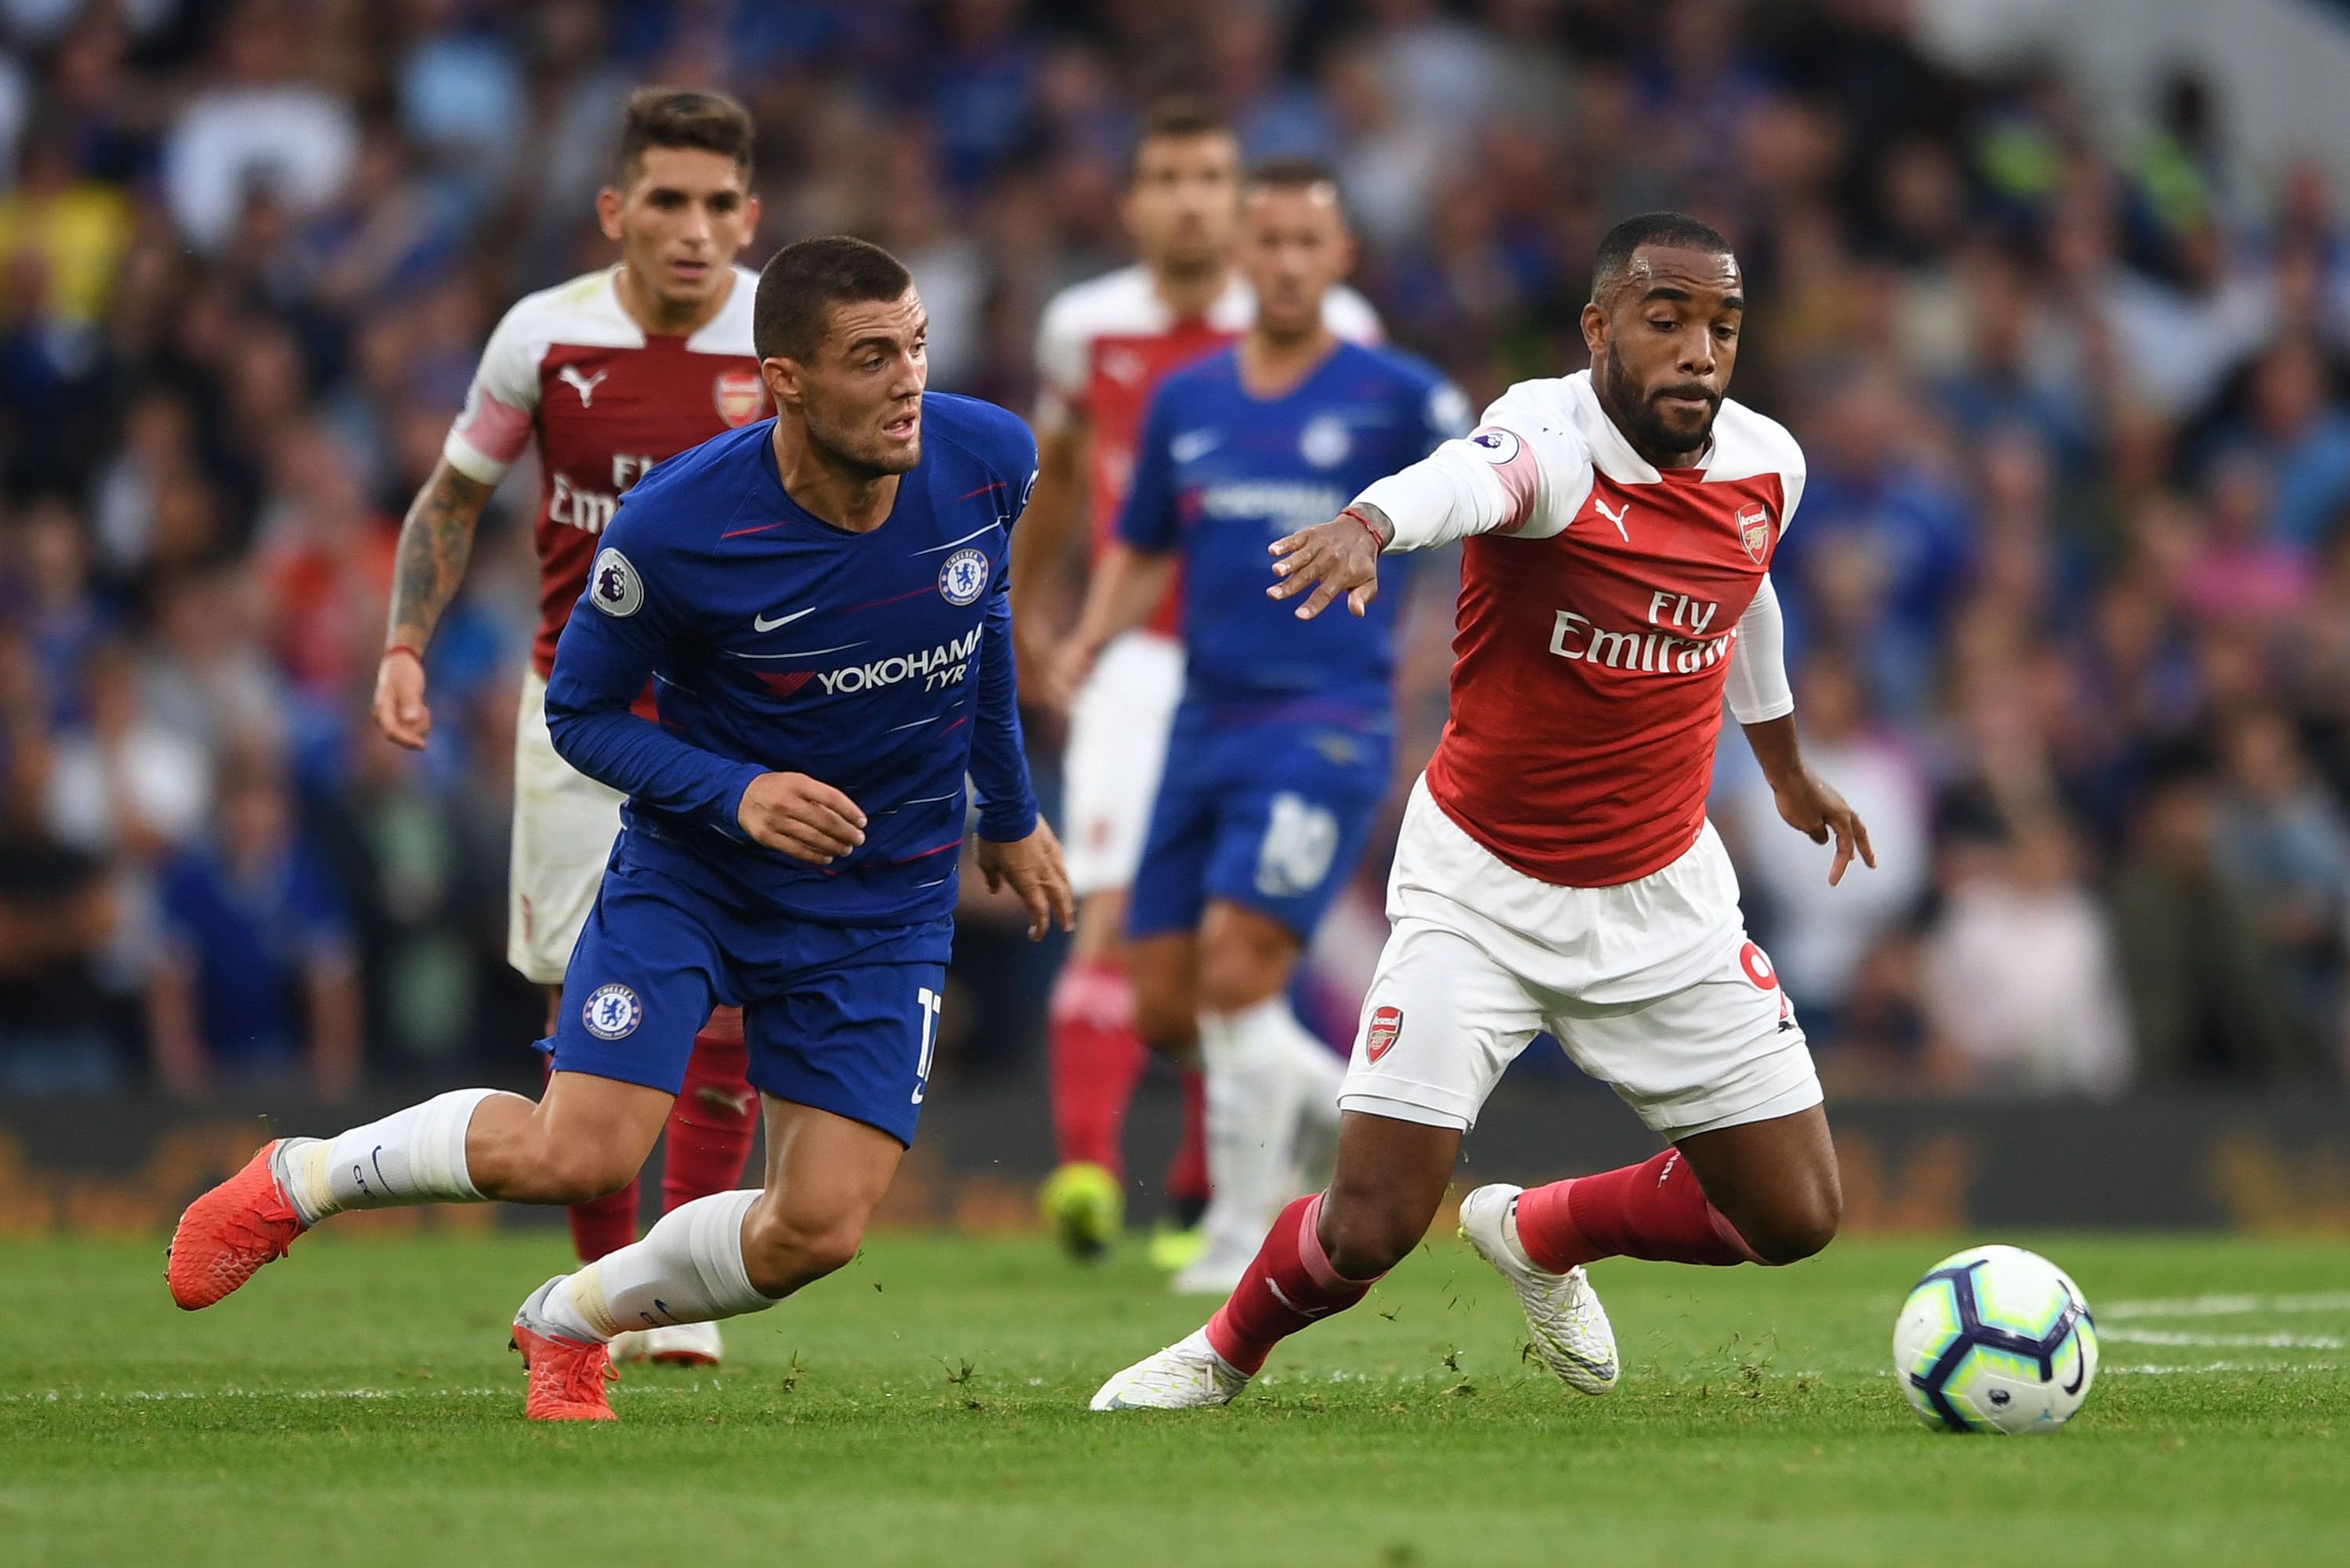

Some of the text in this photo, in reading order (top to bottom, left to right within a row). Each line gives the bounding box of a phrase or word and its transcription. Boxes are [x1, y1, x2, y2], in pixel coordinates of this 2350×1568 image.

[613, 453, 653, 490] Fl
[945, 551, 978, 569] CHELSEA
[1648, 591, 1717, 635] Fly
[924, 658, 973, 692] TYR
